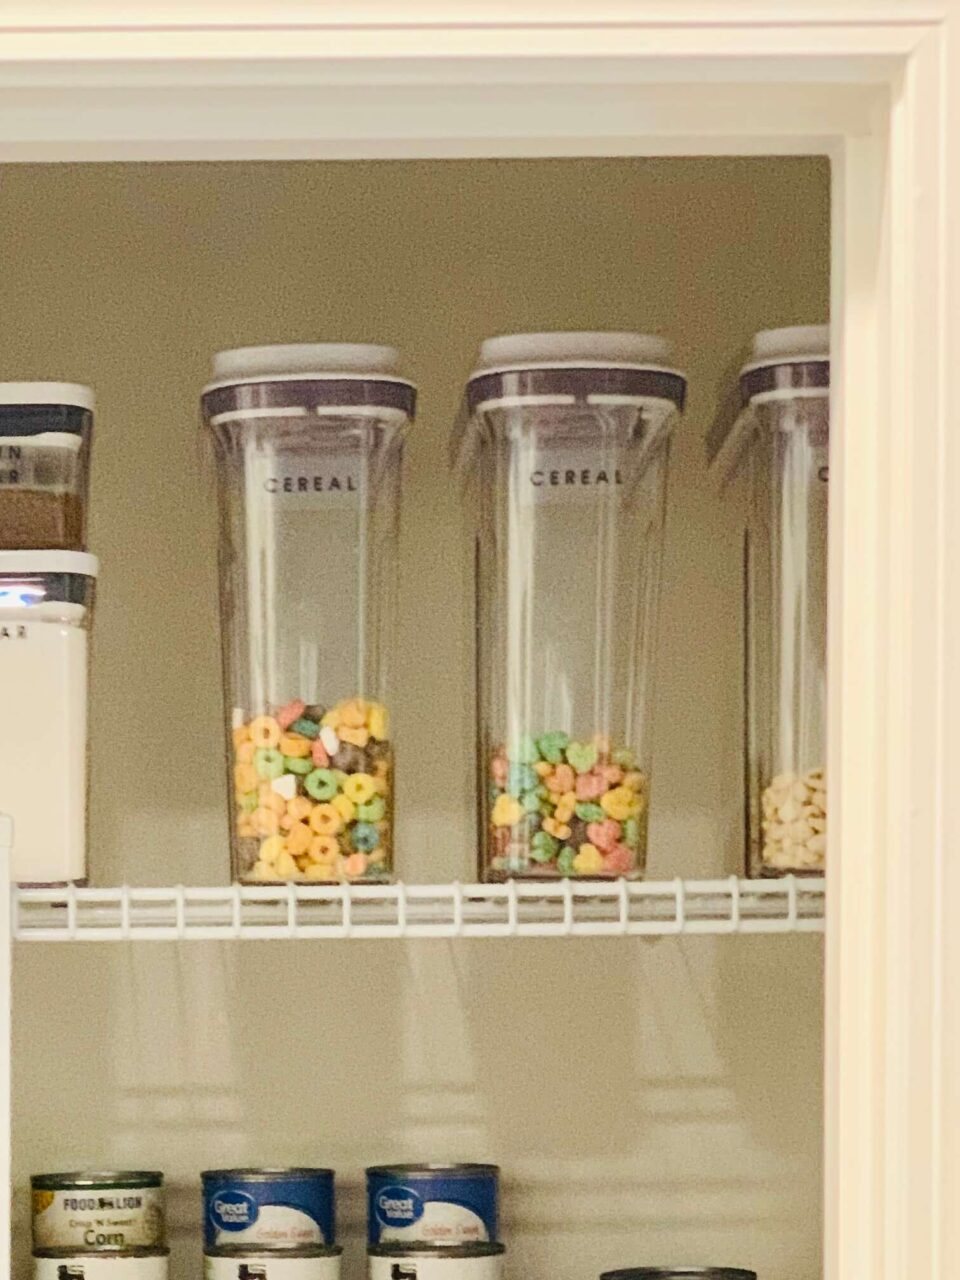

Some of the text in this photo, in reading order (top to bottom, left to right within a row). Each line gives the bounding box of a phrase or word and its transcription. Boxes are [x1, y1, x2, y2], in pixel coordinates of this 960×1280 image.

[264, 477, 357, 493] CEREAL
[530, 469, 623, 486] CEREAL
[63, 1197, 142, 1211] FOOD LION
[214, 1200, 248, 1216] Great
[379, 1196, 414, 1210] Great
[386, 1207, 414, 1219] Value
[84, 1229, 125, 1246] Corn
